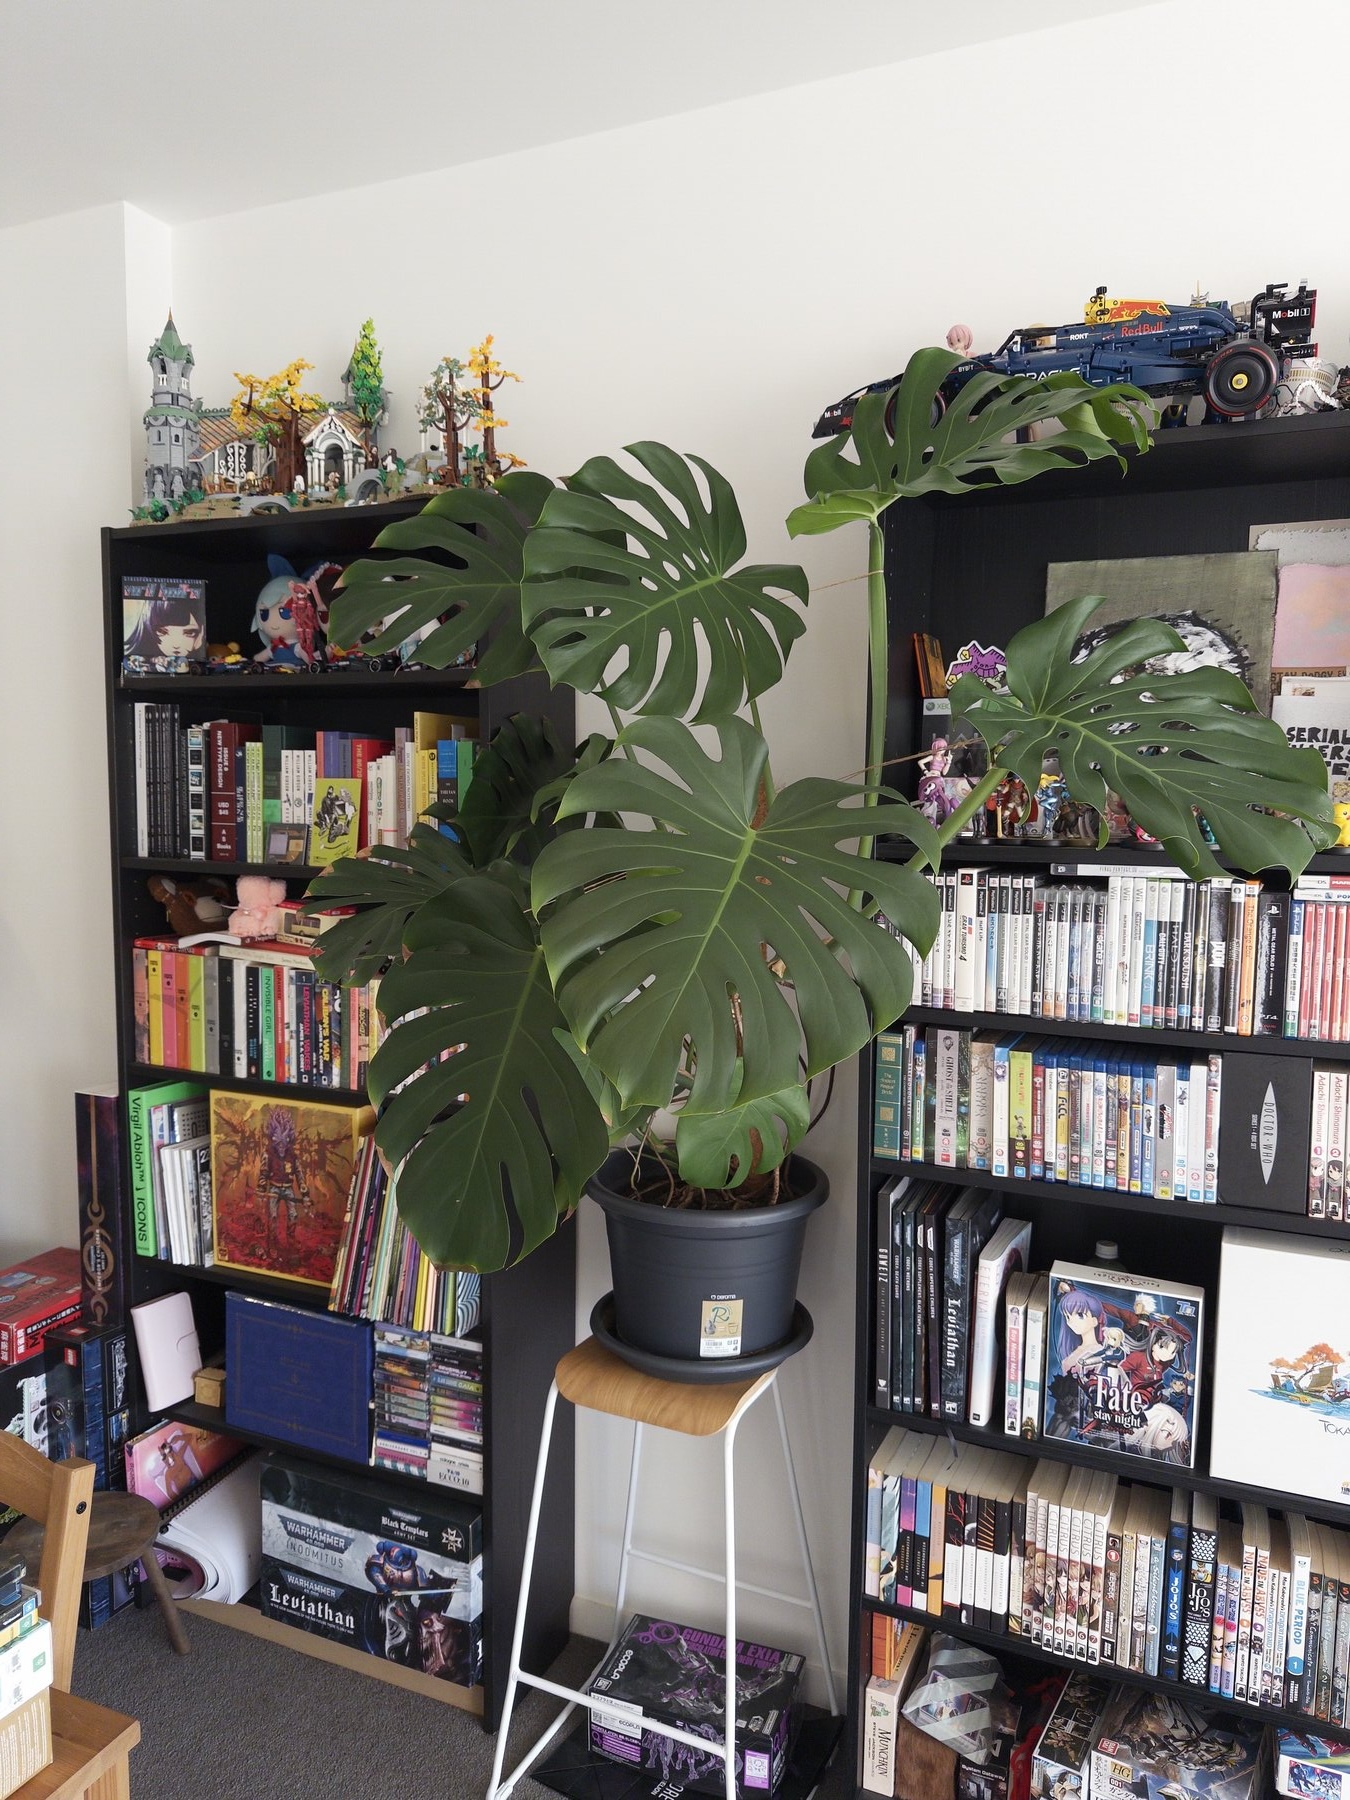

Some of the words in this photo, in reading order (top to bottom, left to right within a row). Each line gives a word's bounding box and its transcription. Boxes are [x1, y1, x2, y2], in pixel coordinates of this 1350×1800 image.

[1273, 309, 1299, 319] Mobil
[825, 410, 841, 418] Mobil
[1286, 727, 1350, 745] SERIAL
[1183, 932, 1191, 954] DARK
[1245, 920, 1254, 944] Orange
[1144, 944, 1155, 980] BRINK
[1181, 954, 1191, 981] SOULS
[1208, 942, 1225, 968] DOOM
[946, 1056, 954, 1082] GHOST
[944, 1090, 952, 1114] SHELL
[1335, 1077, 1343, 1103] Adachi
[131, 1097, 144, 1129] Virgil
[1058, 1096, 1067, 1119] FLCL
[1264, 1102, 1274, 1136] DOCTOR
[1316, 1104, 1325, 1142] Shimamura
[1333, 1106, 1342, 1144] Shimamura
[1262, 1144, 1273, 1164] WHO
[137, 1197, 147, 1242] ICONS
[878, 1248, 888, 1283] GUWEIZ
[952, 1238, 960, 1279] WARHAMMER
[977, 1266, 990, 1320] ETERNAL
[946, 1298, 960, 1367] Leviathan
[1095, 1375, 1142, 1415] Fate
[1094, 1409, 1113, 1424] stay
[1115, 1413, 1141, 1428] night
[381, 1516, 399, 1528] Black
[400, 1522, 429, 1537] Templars
[1027, 1498, 1036, 1536] CITRUS
[1037, 1505, 1046, 1543] CITRUS
[1048, 1511, 1058, 1549] CITRUS
[287, 1521, 345, 1549] WARHAMMER
[1059, 1514, 1069, 1552] CITRUS
[1071, 1516, 1081, 1555] CITRUS
[1083, 1518, 1092, 1557] CITRUS
[1094, 1521, 1104, 1561] CITRUS
[287, 1538, 343, 1568] INDOMITUS
[1243, 1551, 1254, 1576] MADE
[1258, 1555, 1268, 1580] MADE
[287, 1575, 336, 1598] WARHAMMER
[1241, 1584, 1253, 1615] ABYSS
[1295, 1580, 1305, 1605] BLUE
[270, 1583, 354, 1628] Leviathan
[1255, 1588, 1266, 1619] ABYSS
[1293, 1609, 1303, 1645] PERIOD
[1339, 1620, 1347, 1637] Can't
[1166, 1644, 1177, 1652] 02
[1306, 1627, 1316, 1667] Communicate
[1336, 1637, 1345, 1679] Communicate
[876, 1728, 891, 1777] MUNCHKIN
[962, 1764, 981, 1773] System
[982, 1770, 1005, 1781] Gateway
[1111, 1779, 1122, 1787] 001
[1112, 1764, 1131, 1778] HG
